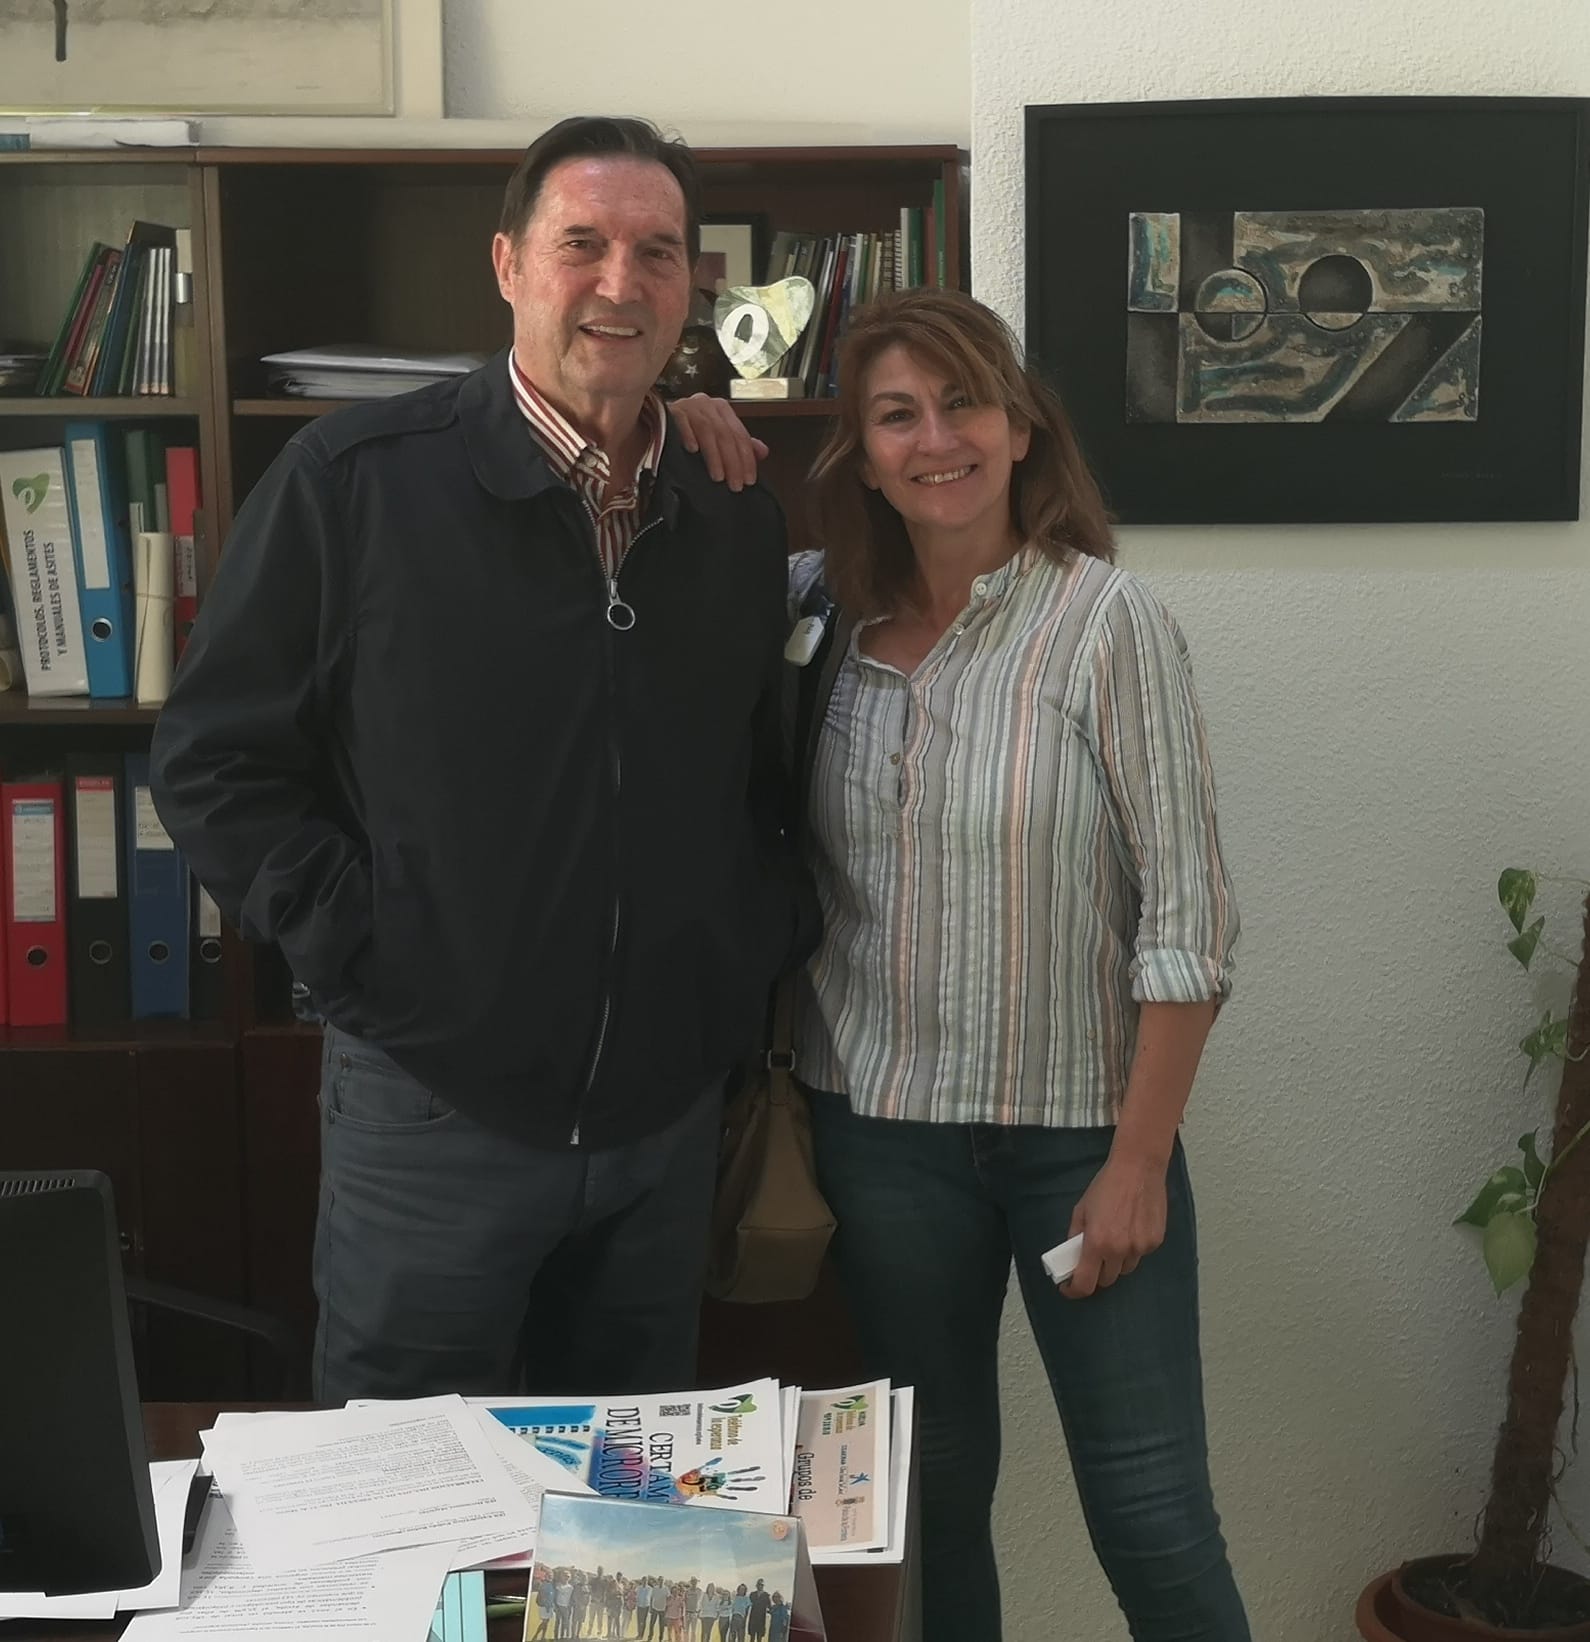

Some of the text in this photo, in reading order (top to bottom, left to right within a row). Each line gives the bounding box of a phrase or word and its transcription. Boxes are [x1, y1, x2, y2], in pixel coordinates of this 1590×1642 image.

[23, 529, 51, 671] PROTOCOLOS, REGLAMENTOS
[48, 578, 59, 591] DE
[50, 592, 67, 649] MANUALES
[707, 1423, 723, 1450] esperanza
[727, 1438, 742, 1446] de
[647, 1432, 674, 1502] CERTAM
[793, 1452, 817, 1501] Grupos de
